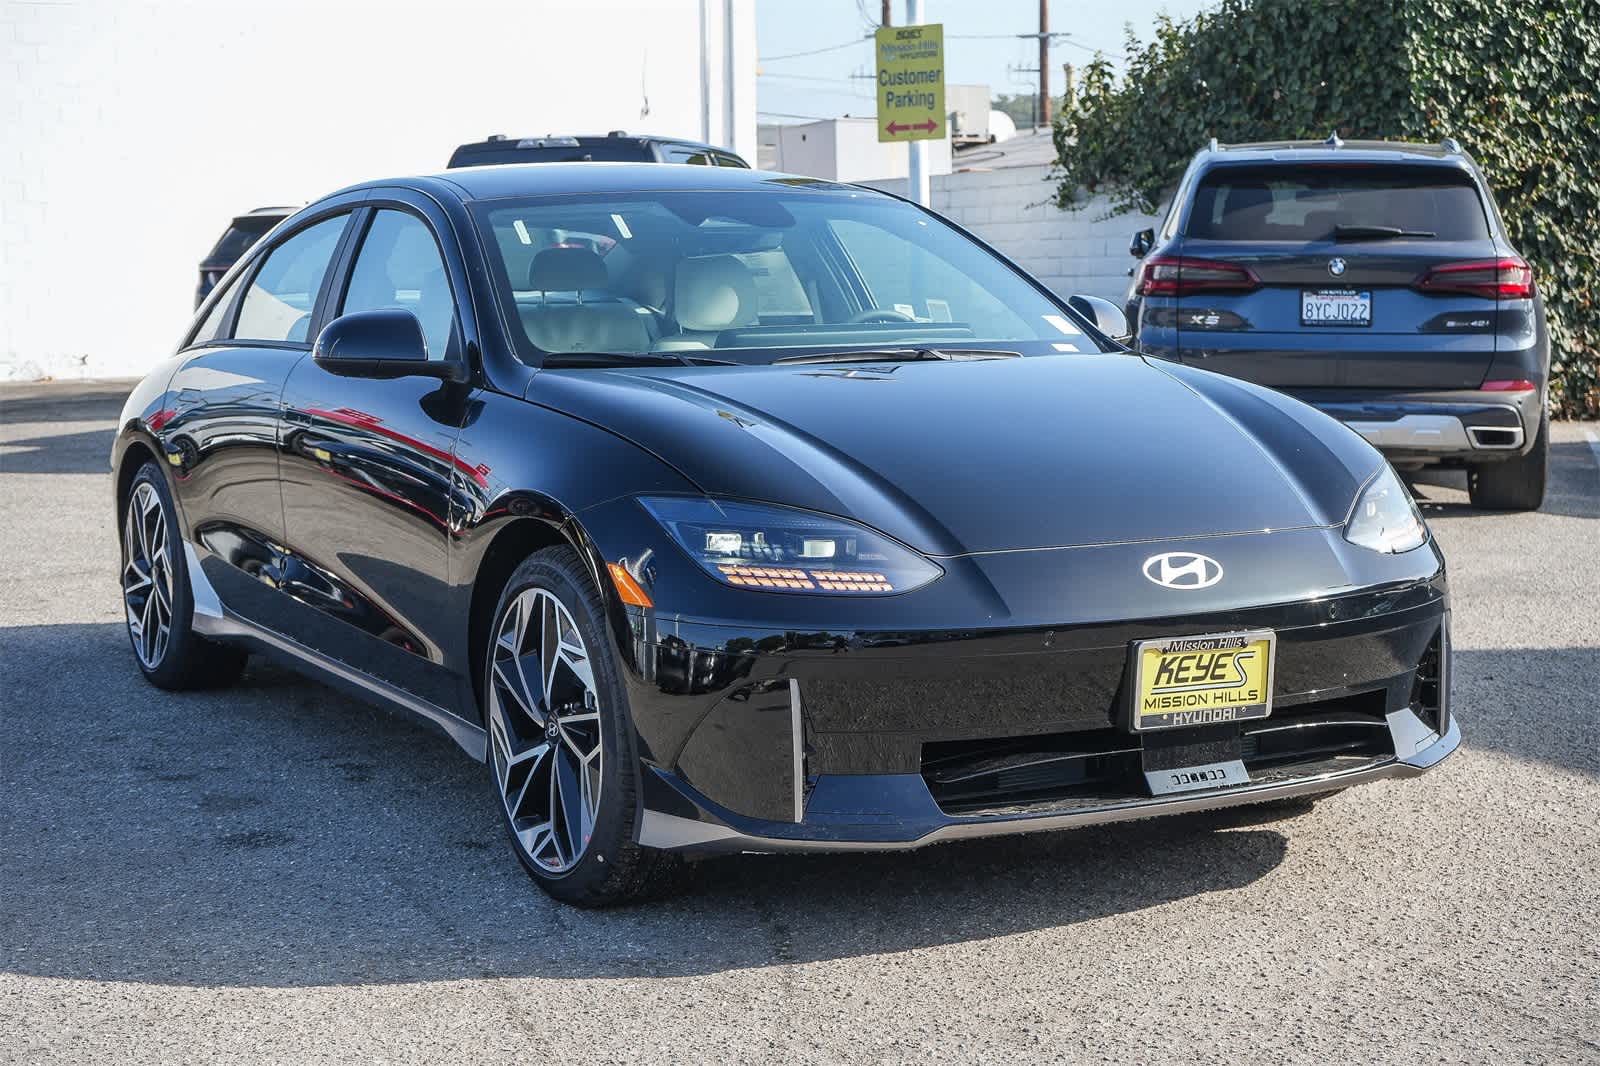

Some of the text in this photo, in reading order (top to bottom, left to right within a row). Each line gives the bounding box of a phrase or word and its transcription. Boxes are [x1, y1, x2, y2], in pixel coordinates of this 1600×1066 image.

[879, 69, 942, 87] Customer
[886, 91, 936, 111] Parking
[1305, 303, 1368, 320] 8YCJ022
[1171, 637, 1243, 653] Mission Hills
[1152, 650, 1256, 688] KEYES
[1144, 689, 1259, 711] MISSION HILLS
[1173, 707, 1237, 726] HYUNDAI
